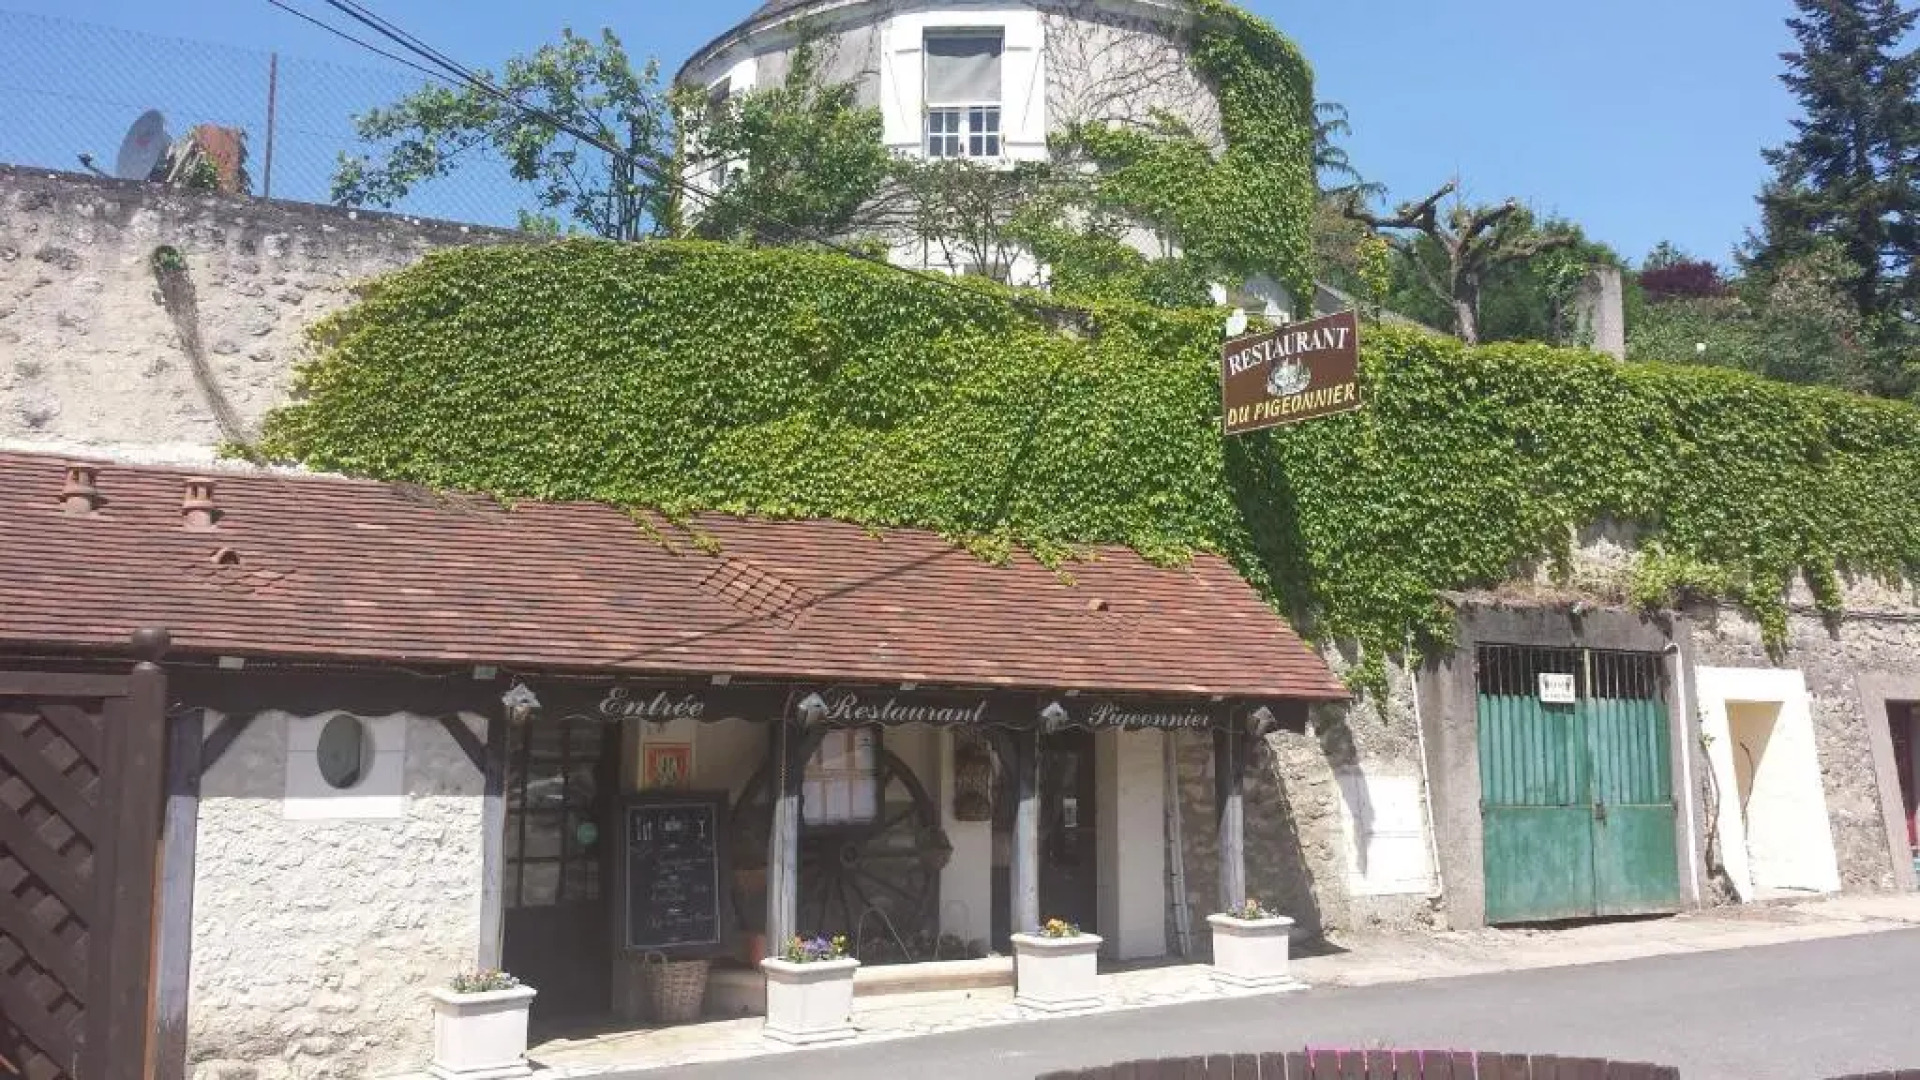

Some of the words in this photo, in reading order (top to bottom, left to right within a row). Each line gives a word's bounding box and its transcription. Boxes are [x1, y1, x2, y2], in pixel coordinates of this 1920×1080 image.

[1228, 327, 1349, 375] RESTAURANT
[1227, 405, 1249, 426] DU
[1254, 382, 1355, 420] PIGEONNIER
[599, 687, 704, 719] Entrée
[825, 687, 988, 722] Restaurant
[1088, 702, 1209, 728] Pigeonnier
